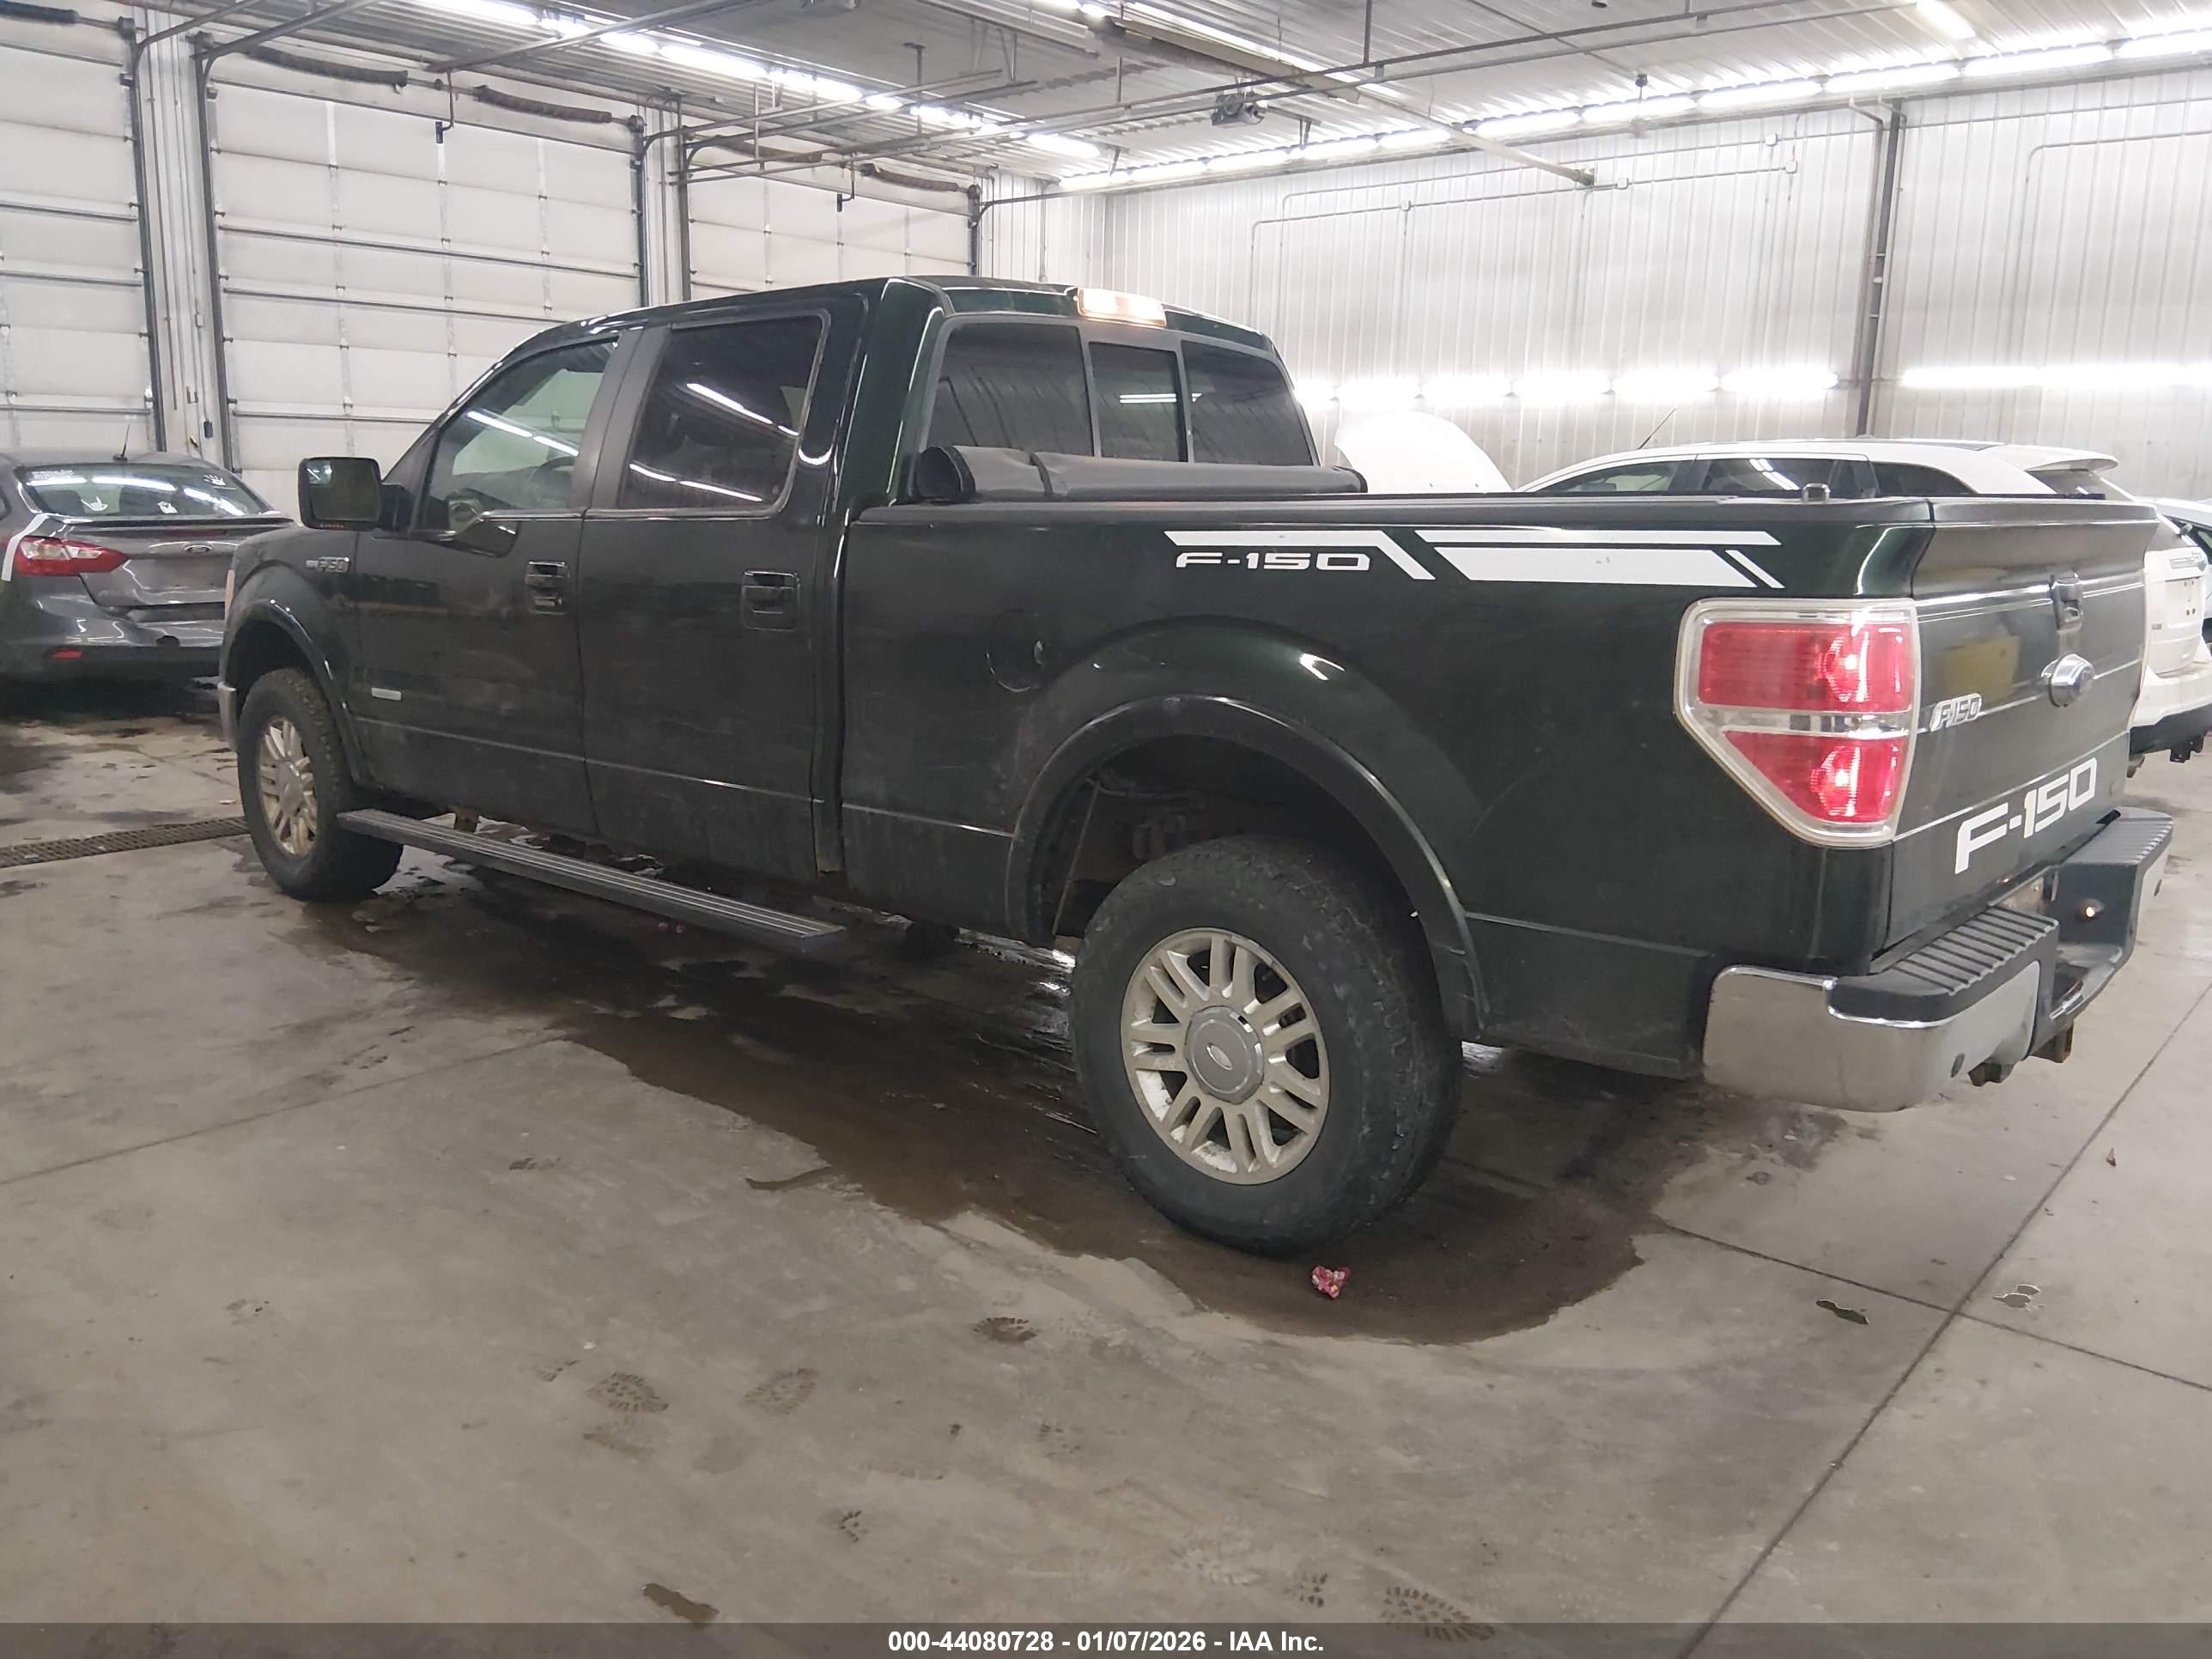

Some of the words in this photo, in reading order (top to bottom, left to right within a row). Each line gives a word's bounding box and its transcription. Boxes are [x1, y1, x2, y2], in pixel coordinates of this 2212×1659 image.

[1176, 552, 1370, 571] F-150
[1929, 692, 1982, 732] F-150
[1954, 757, 2098, 875] F-150
